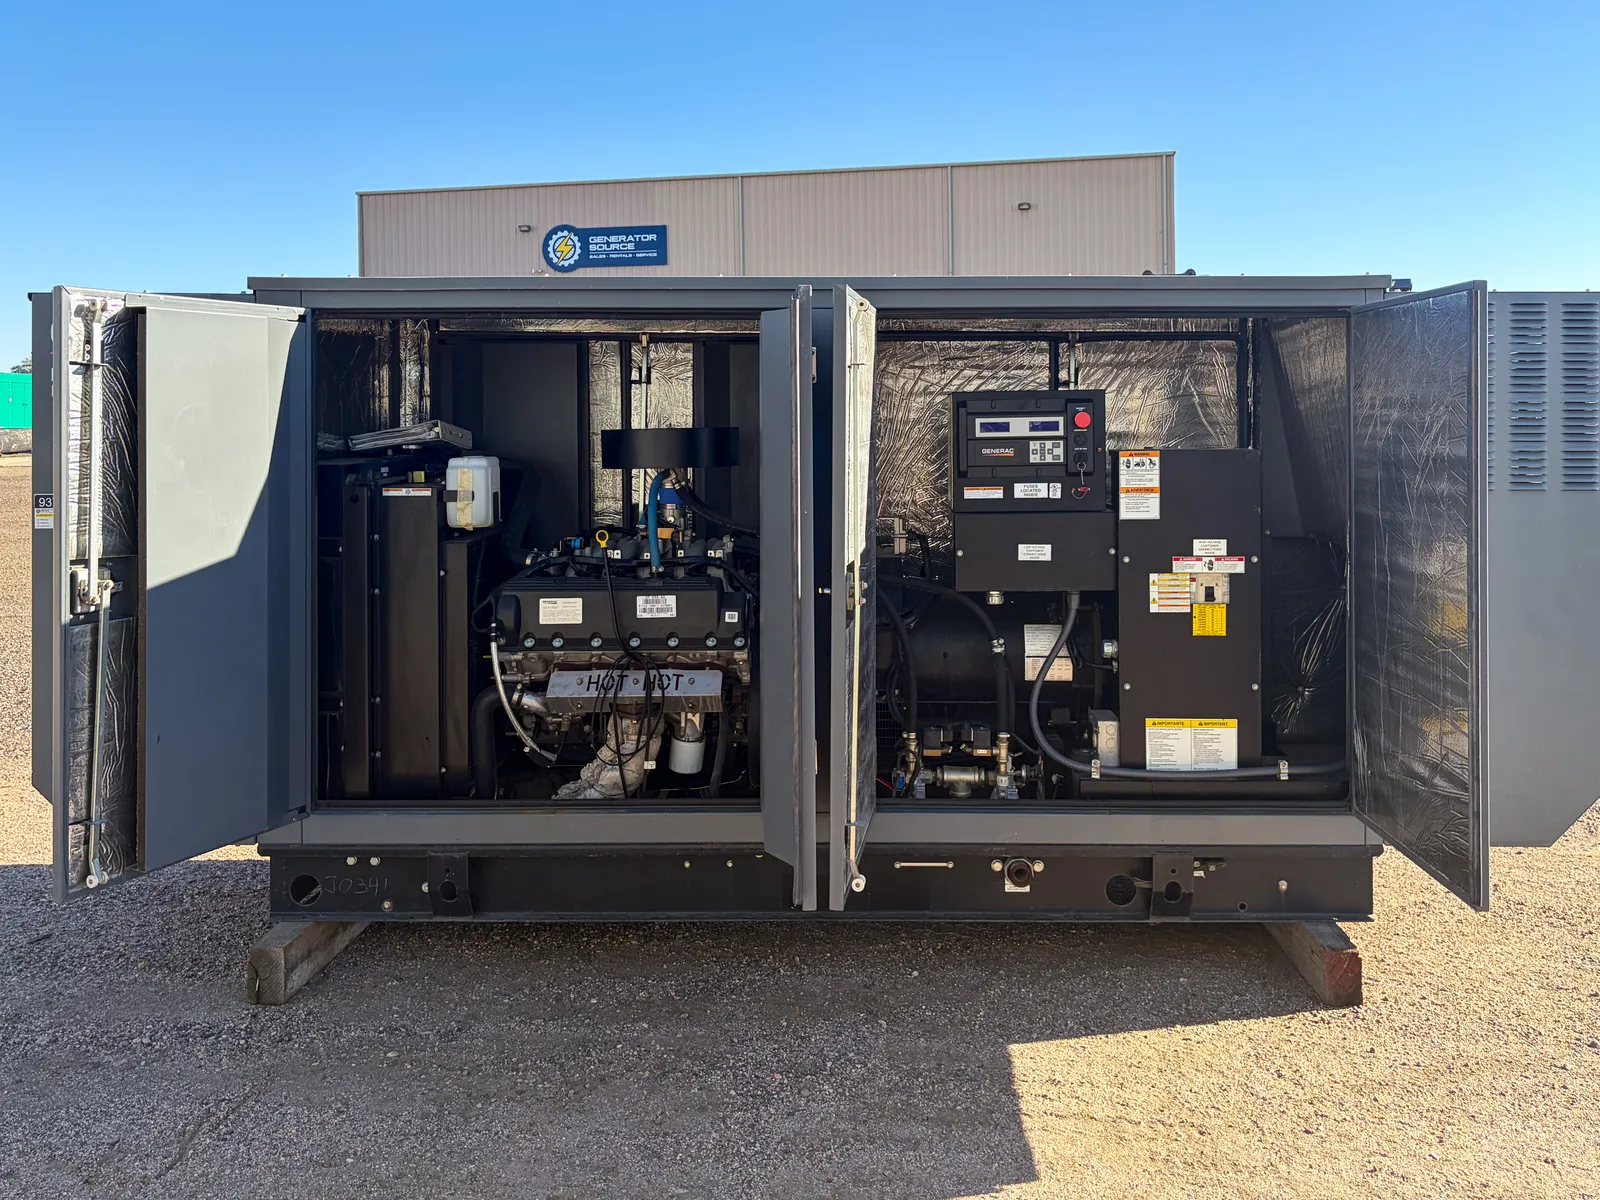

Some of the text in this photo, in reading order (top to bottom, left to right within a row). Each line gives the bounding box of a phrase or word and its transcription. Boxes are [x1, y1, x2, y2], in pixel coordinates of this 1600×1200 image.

[589, 234, 657, 243] GENERATOR
[589, 243, 635, 251] SOURCE
[586, 674, 684, 692] HOT HOT
